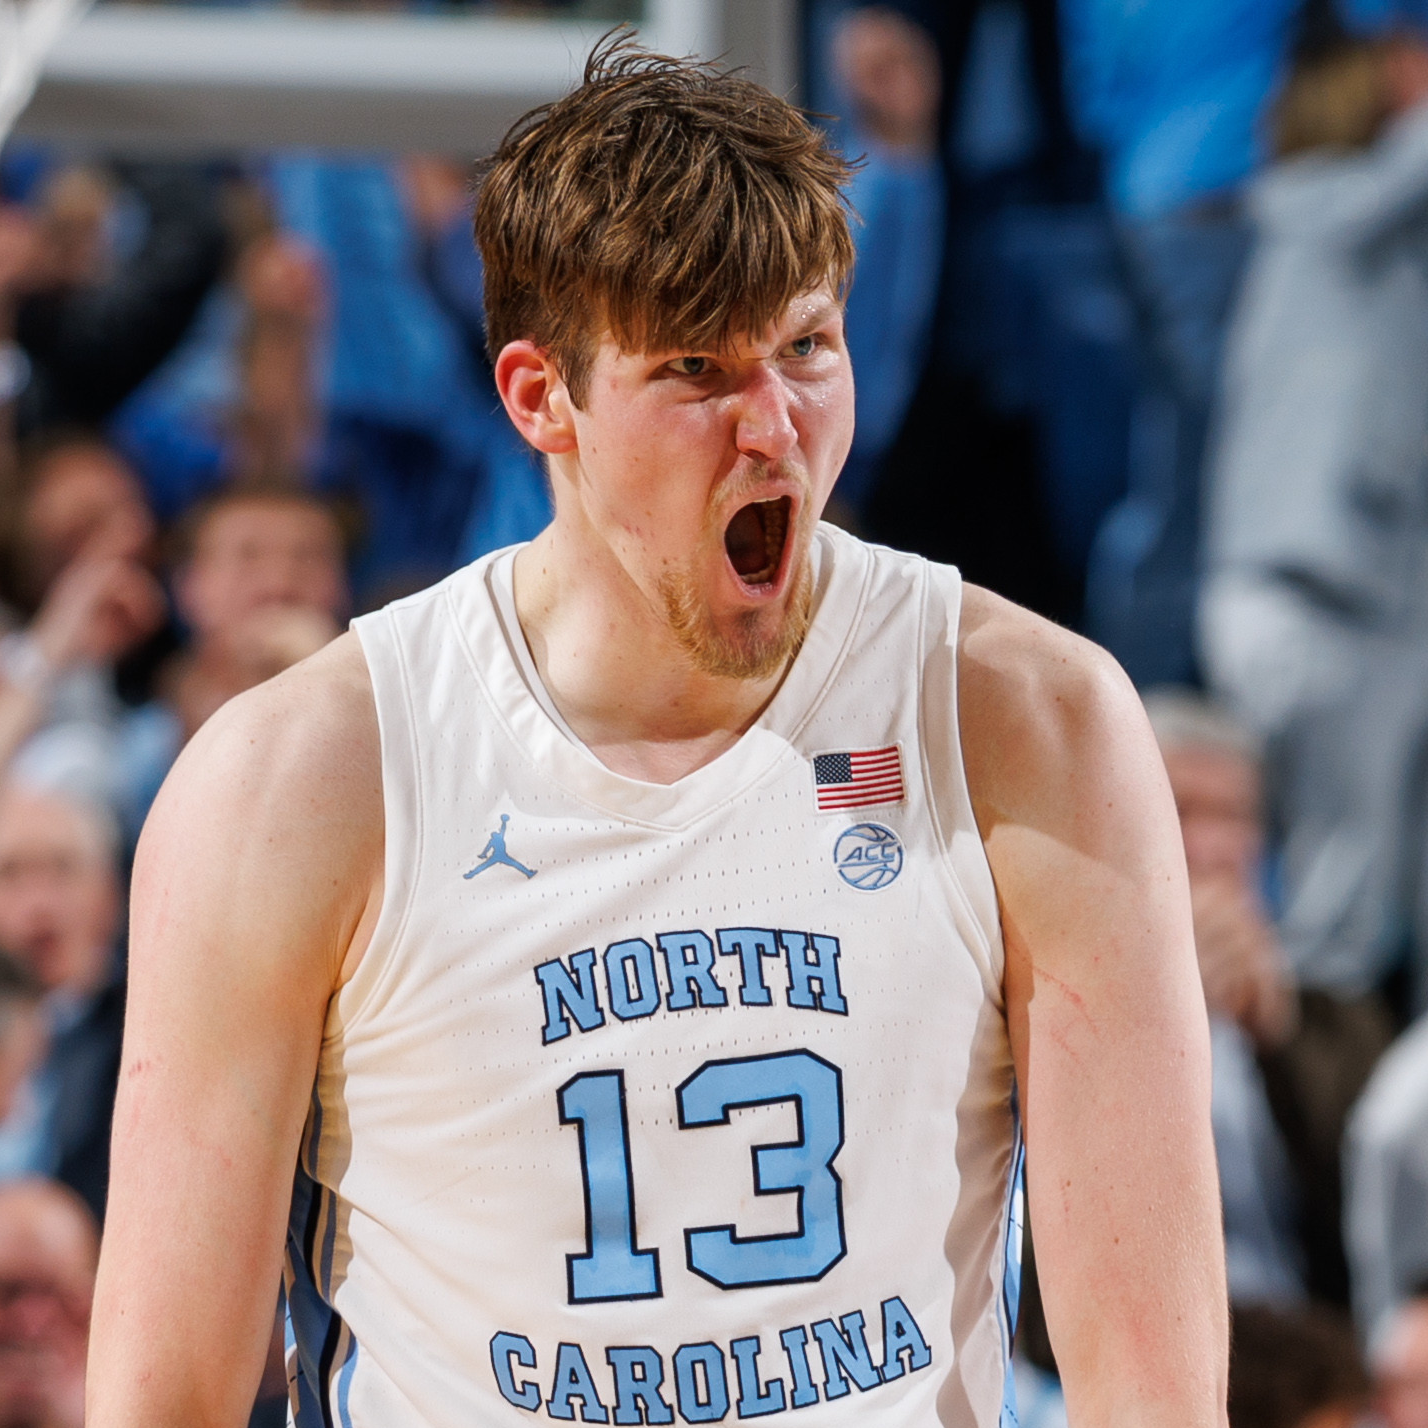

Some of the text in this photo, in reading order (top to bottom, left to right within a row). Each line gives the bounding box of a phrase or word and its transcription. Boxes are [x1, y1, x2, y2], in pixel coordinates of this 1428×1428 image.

[842, 841, 898, 863] ACC
[534, 926, 849, 1046] NORTH
[555, 1047, 848, 1305] 13
[489, 1295, 932, 1426] CAROLINA
